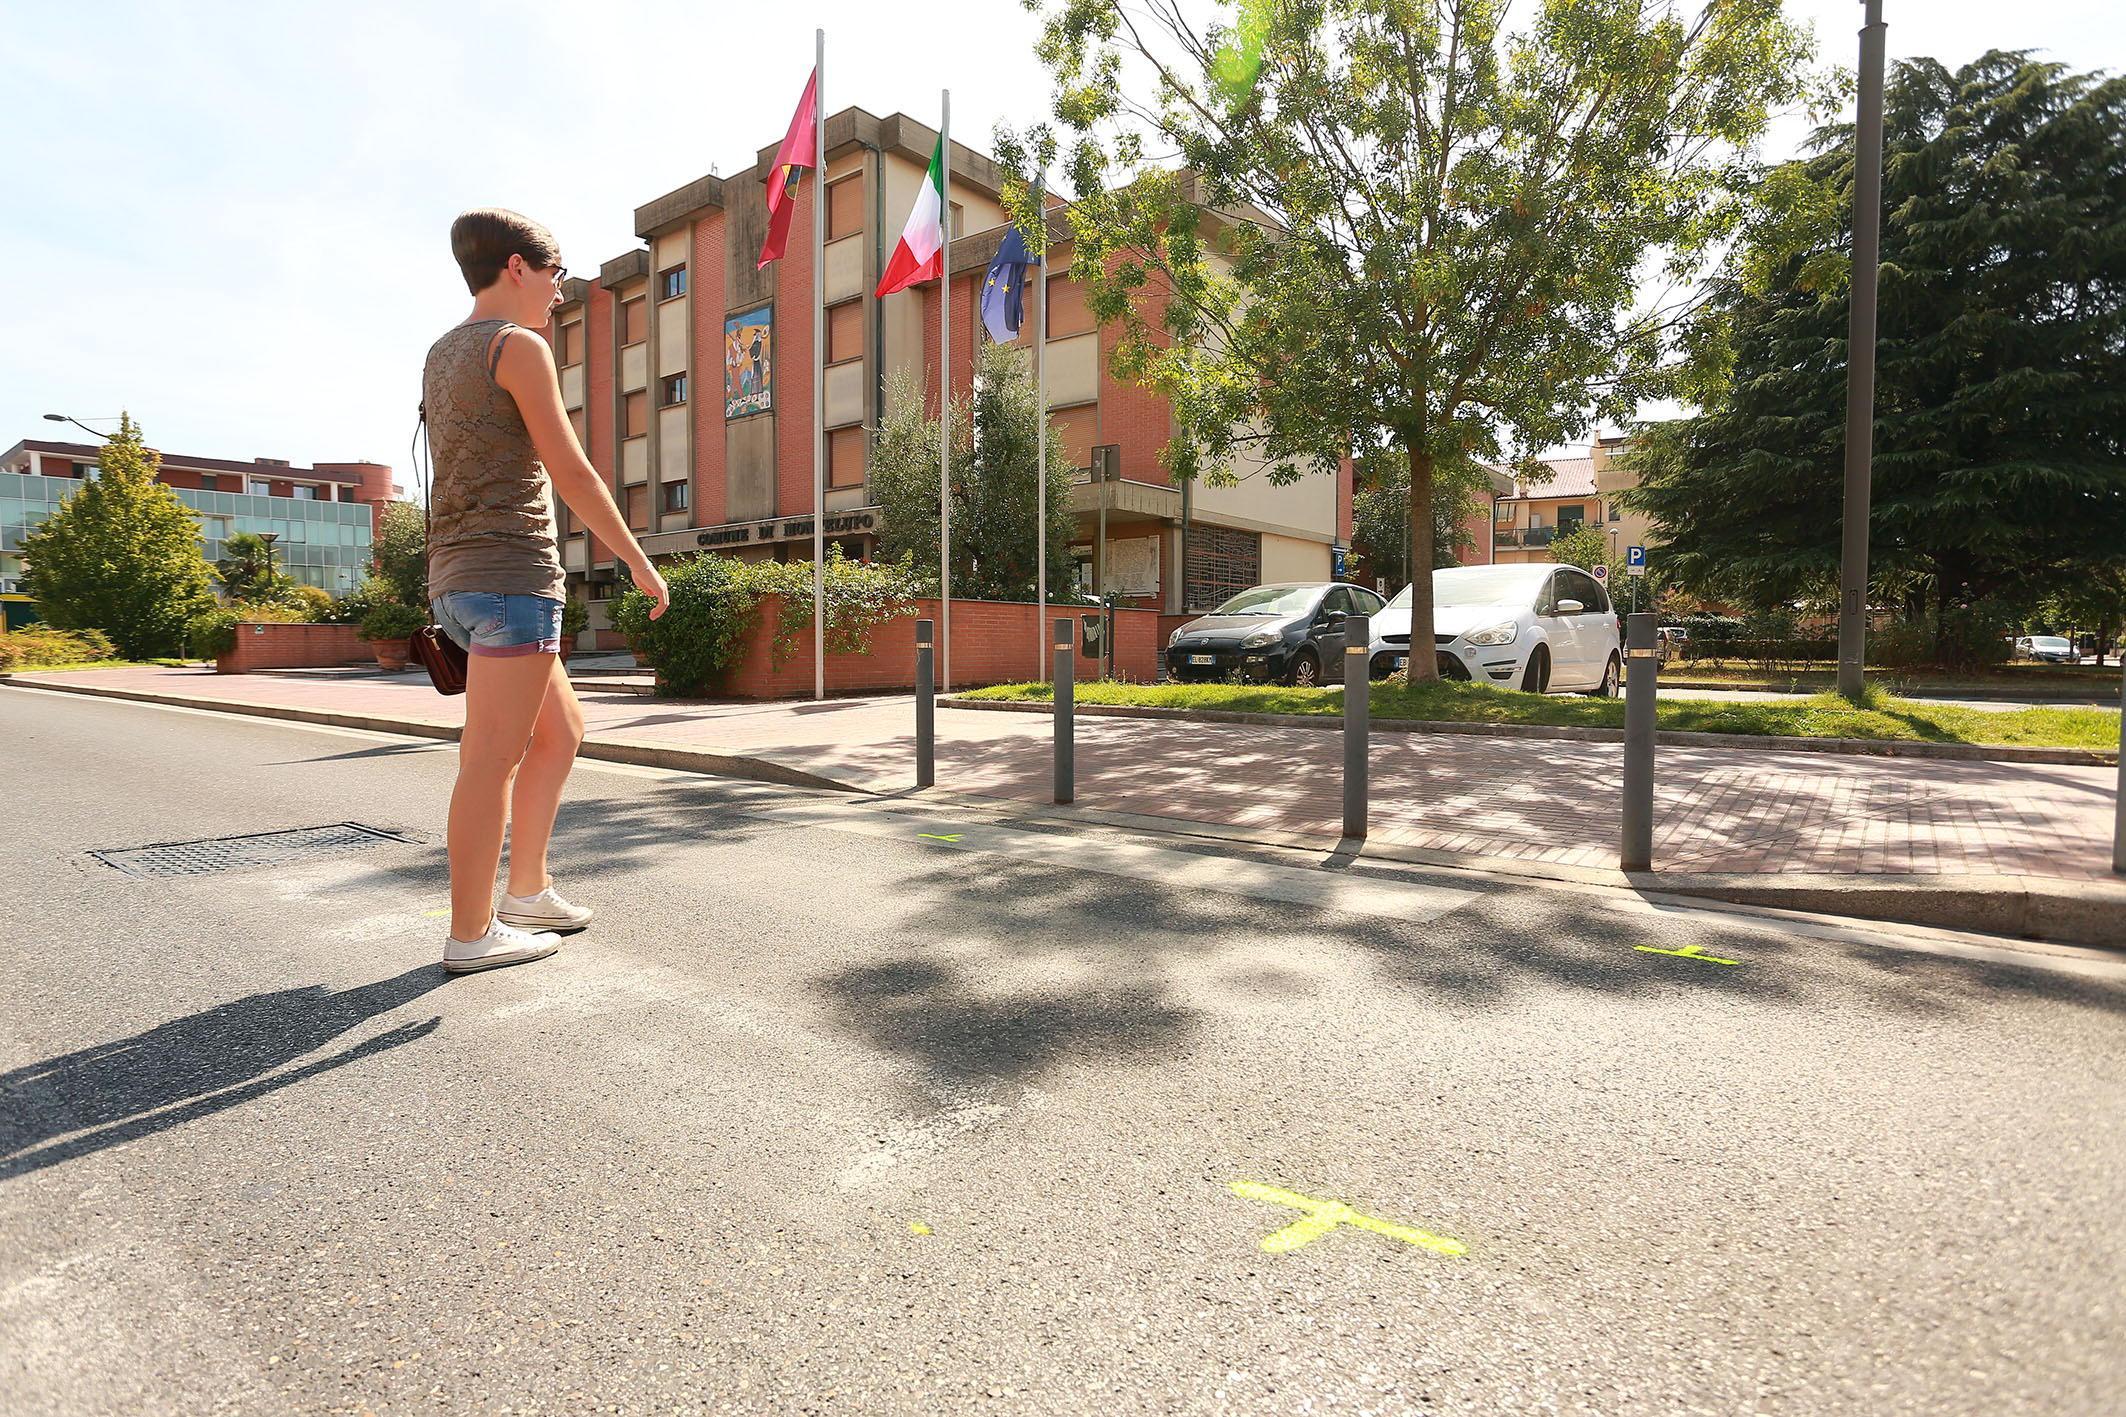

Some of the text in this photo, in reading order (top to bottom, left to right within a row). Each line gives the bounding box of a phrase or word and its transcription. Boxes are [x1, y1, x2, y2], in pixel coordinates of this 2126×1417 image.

[696, 514, 874, 546] COMUNE DI MONELUPO
[1337, 555, 1343, 566] P
[1630, 548, 1642, 564] P
